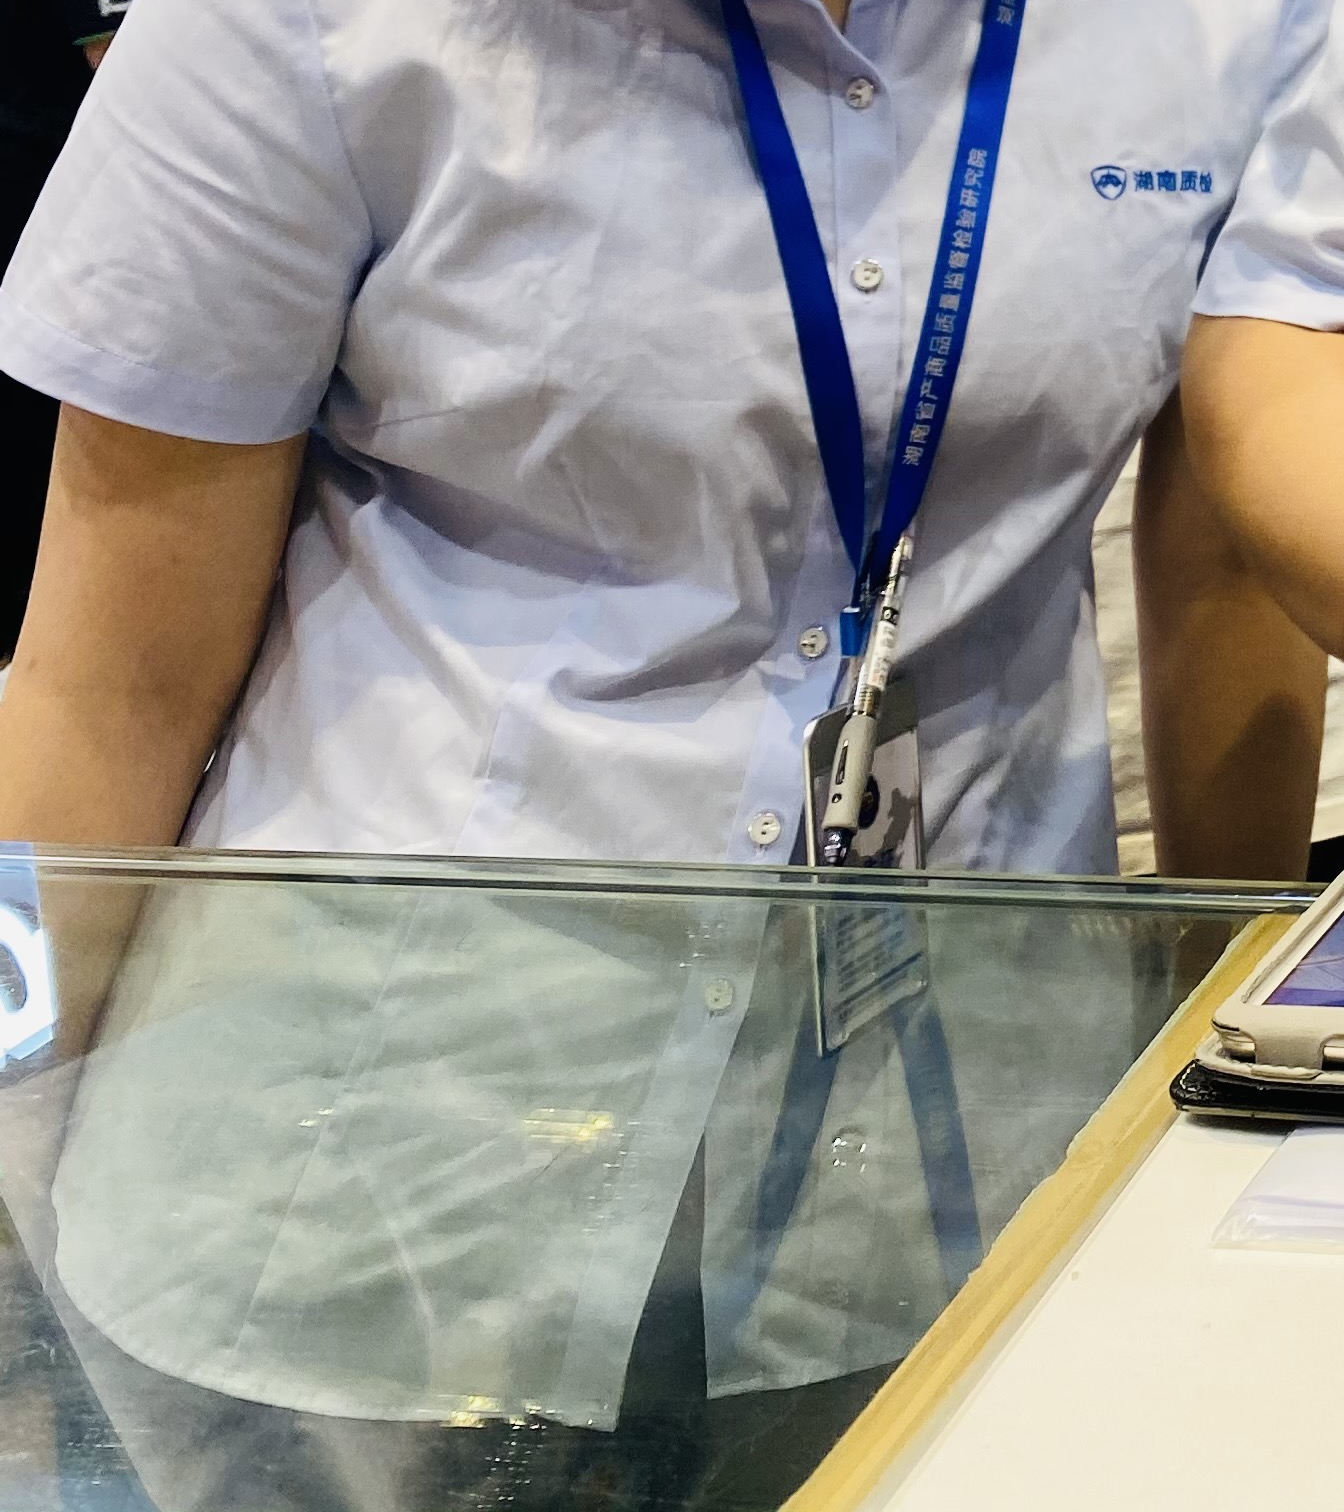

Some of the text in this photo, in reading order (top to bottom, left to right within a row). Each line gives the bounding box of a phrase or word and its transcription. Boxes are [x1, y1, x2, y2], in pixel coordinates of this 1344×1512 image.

[1132, 170, 1213, 194] 湖南质检
[901, 147, 989, 467] 湖南省产商品质量监督检验研究院
